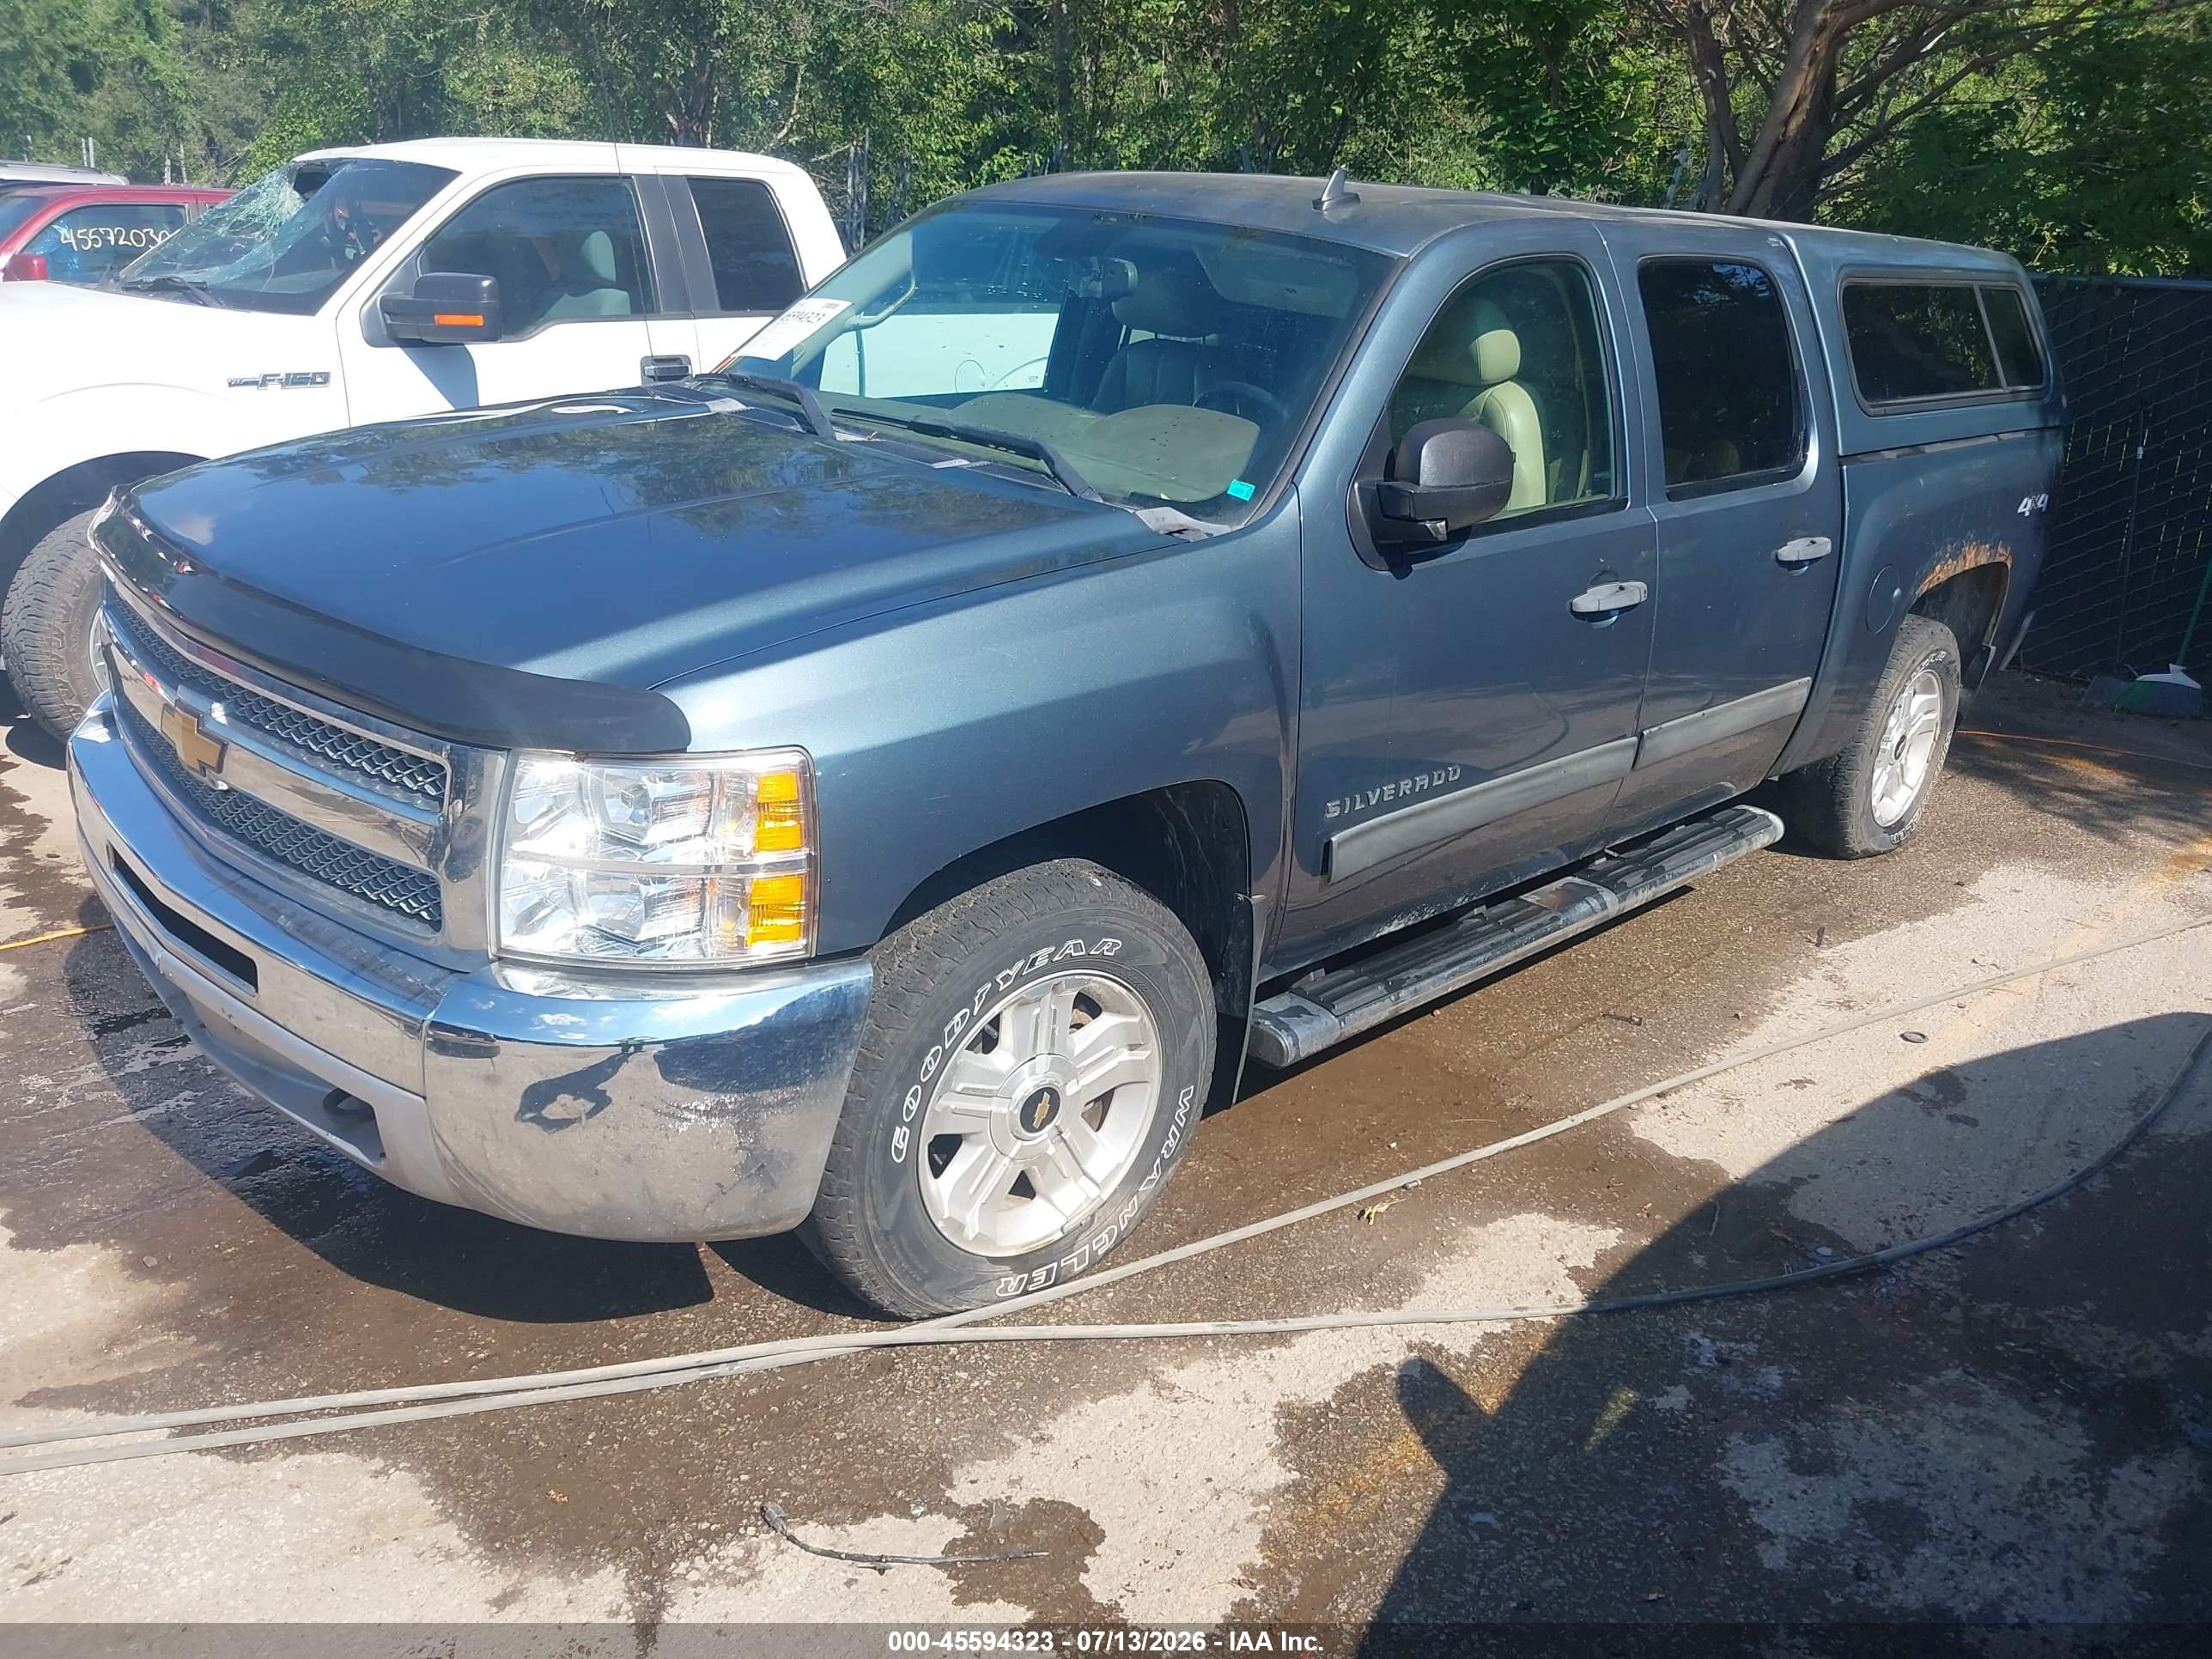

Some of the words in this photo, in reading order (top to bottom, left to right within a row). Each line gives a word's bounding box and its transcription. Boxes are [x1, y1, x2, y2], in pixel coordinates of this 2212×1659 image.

[1324, 764, 1462, 819] SILVERADO
[890, 938, 1122, 1164] GOODYEAR
[995, 1085, 1194, 1297] WRANGLER
